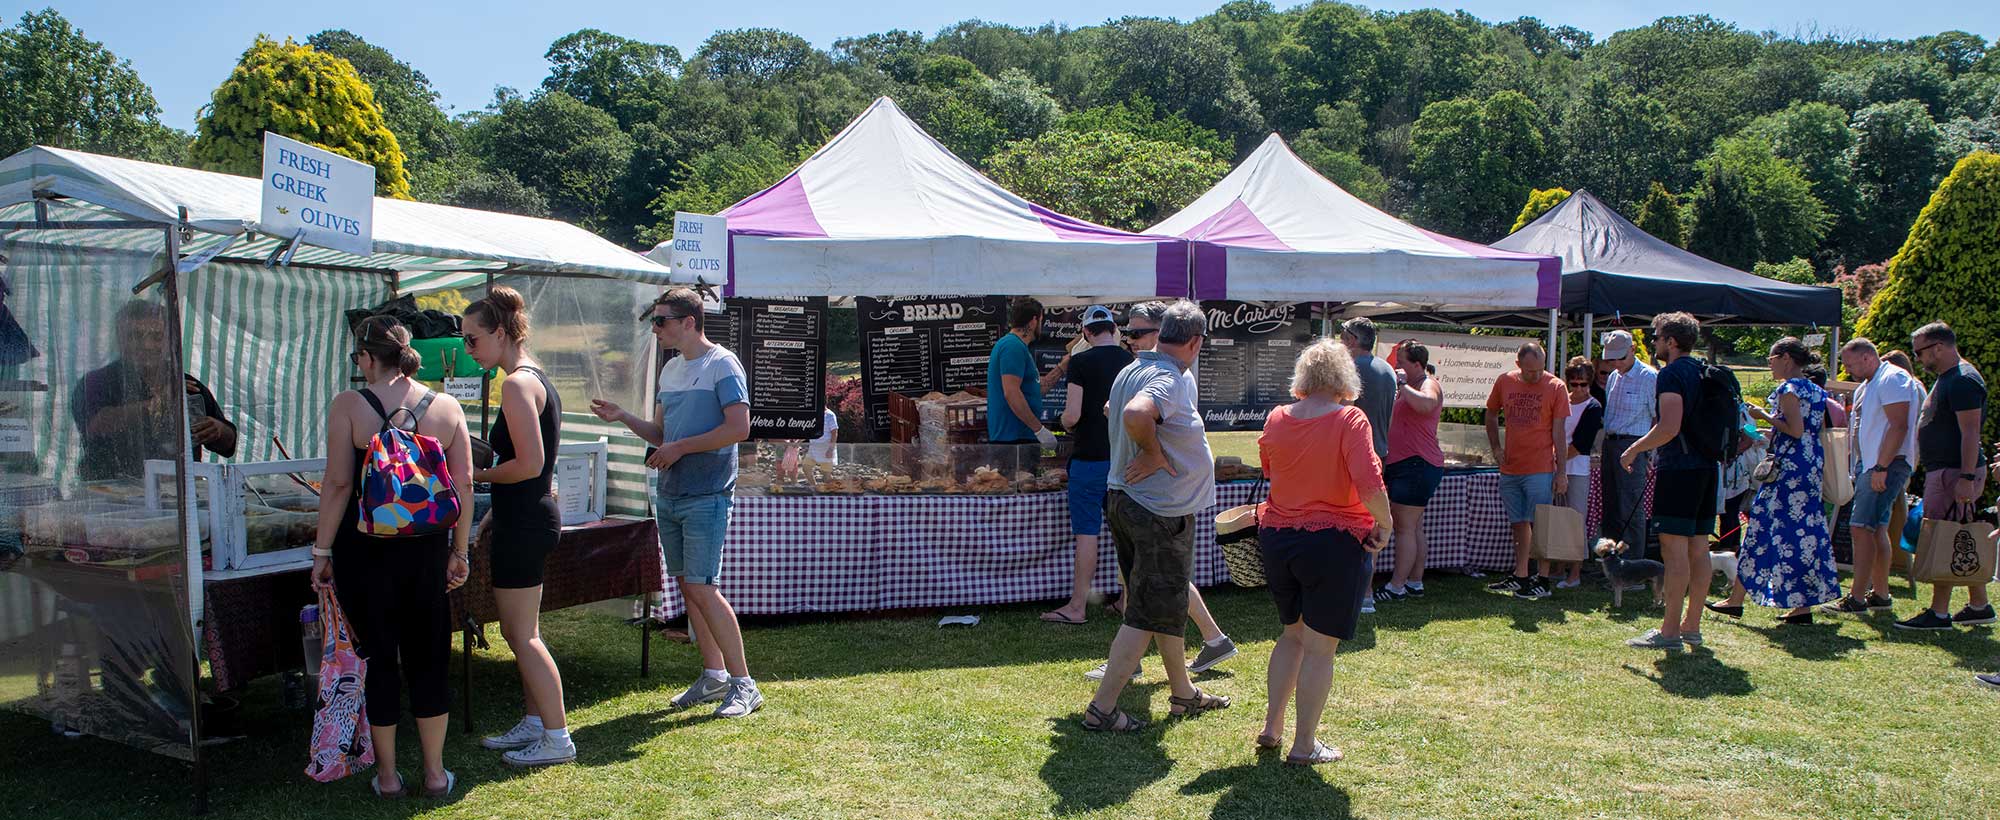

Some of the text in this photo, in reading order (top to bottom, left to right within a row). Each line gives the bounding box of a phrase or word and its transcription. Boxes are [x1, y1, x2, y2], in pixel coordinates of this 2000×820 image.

[278, 148, 331, 179] FRESH
[272, 173, 328, 203] GREEK
[301, 208, 360, 236] OLIVES
[678, 221, 702, 234] FRESH
[675, 239, 701, 252] GREEK
[689, 258, 720, 270] OLIVES
[902, 303, 964, 322] BREAD
[1446, 342, 1469, 353] Locally
[1470, 344, 1498, 352] sourced
[1444, 358, 1483, 368] Homemade
[1442, 374, 1455, 383] Paw
[1443, 391, 1487, 401] iodegradable
[750, 416, 816, 431] Here to tempt
[1205, 409, 1266, 426] Freshly baked
